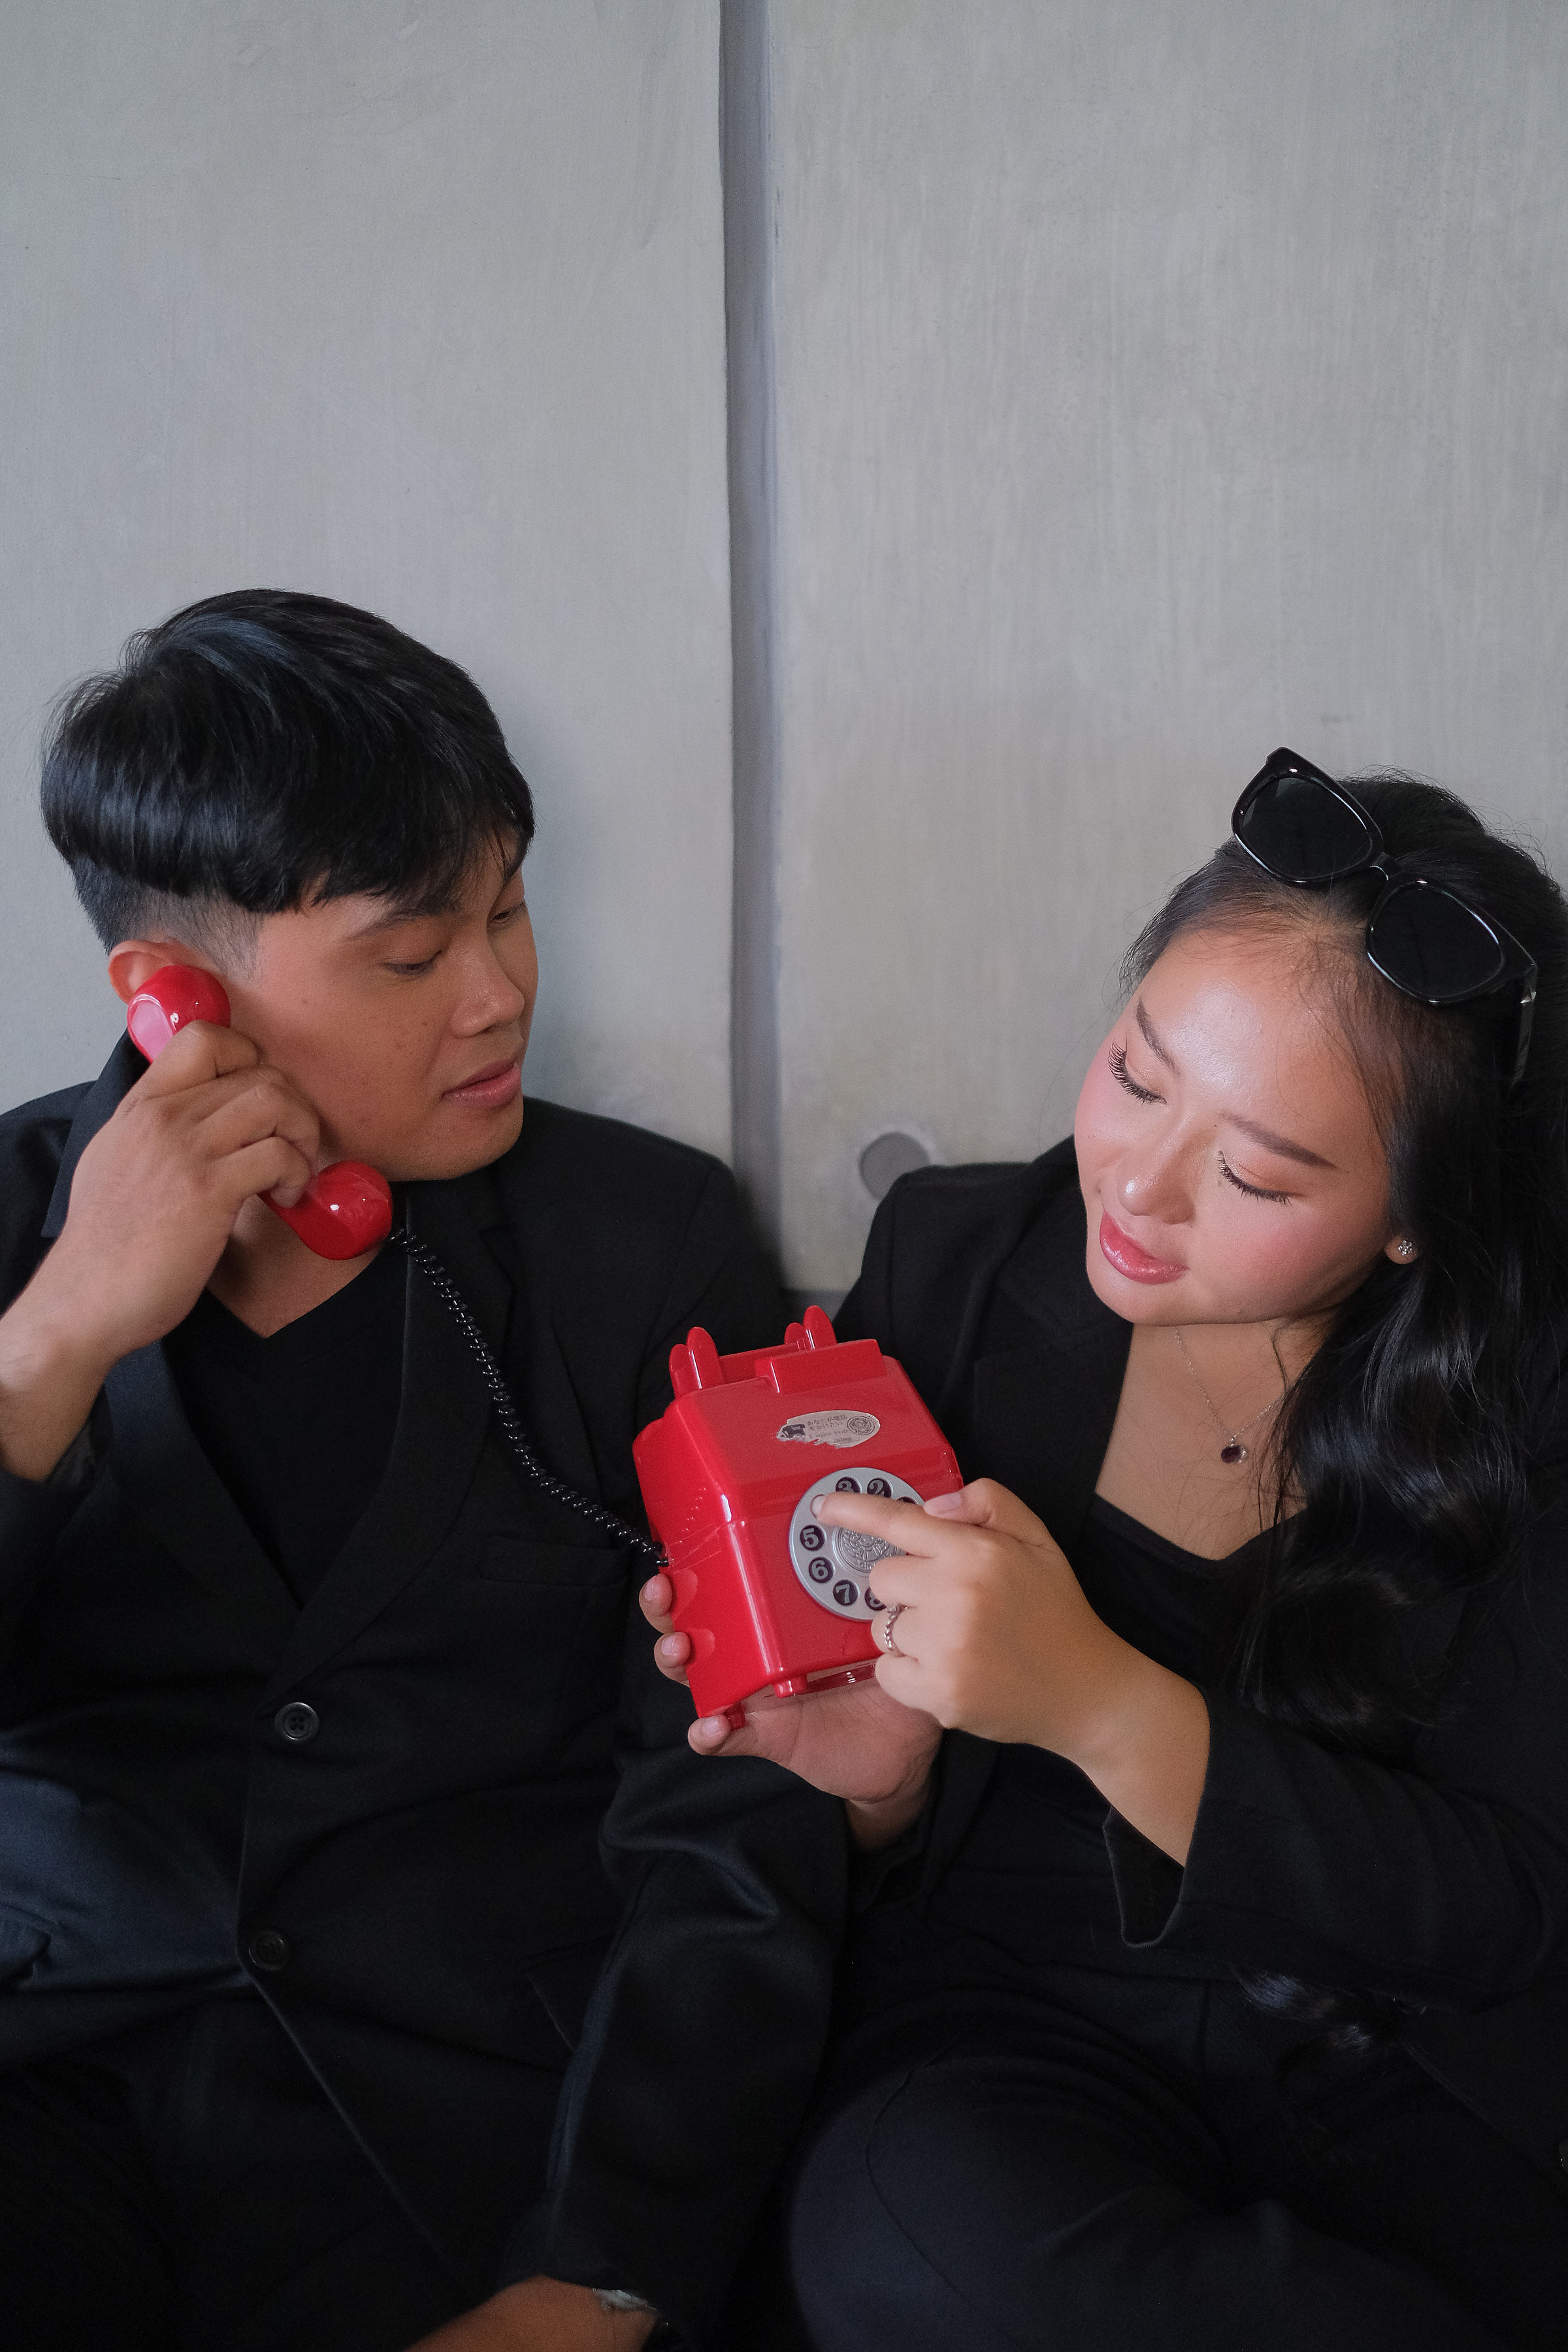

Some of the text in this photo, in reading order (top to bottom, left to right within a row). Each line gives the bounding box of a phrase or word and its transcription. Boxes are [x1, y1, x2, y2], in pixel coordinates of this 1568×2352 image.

[869, 1479, 885, 1495] 2
[802, 1528, 819, 1548] 5
[811, 1560, 828, 1580] 6
[836, 1583, 850, 1604] 7
